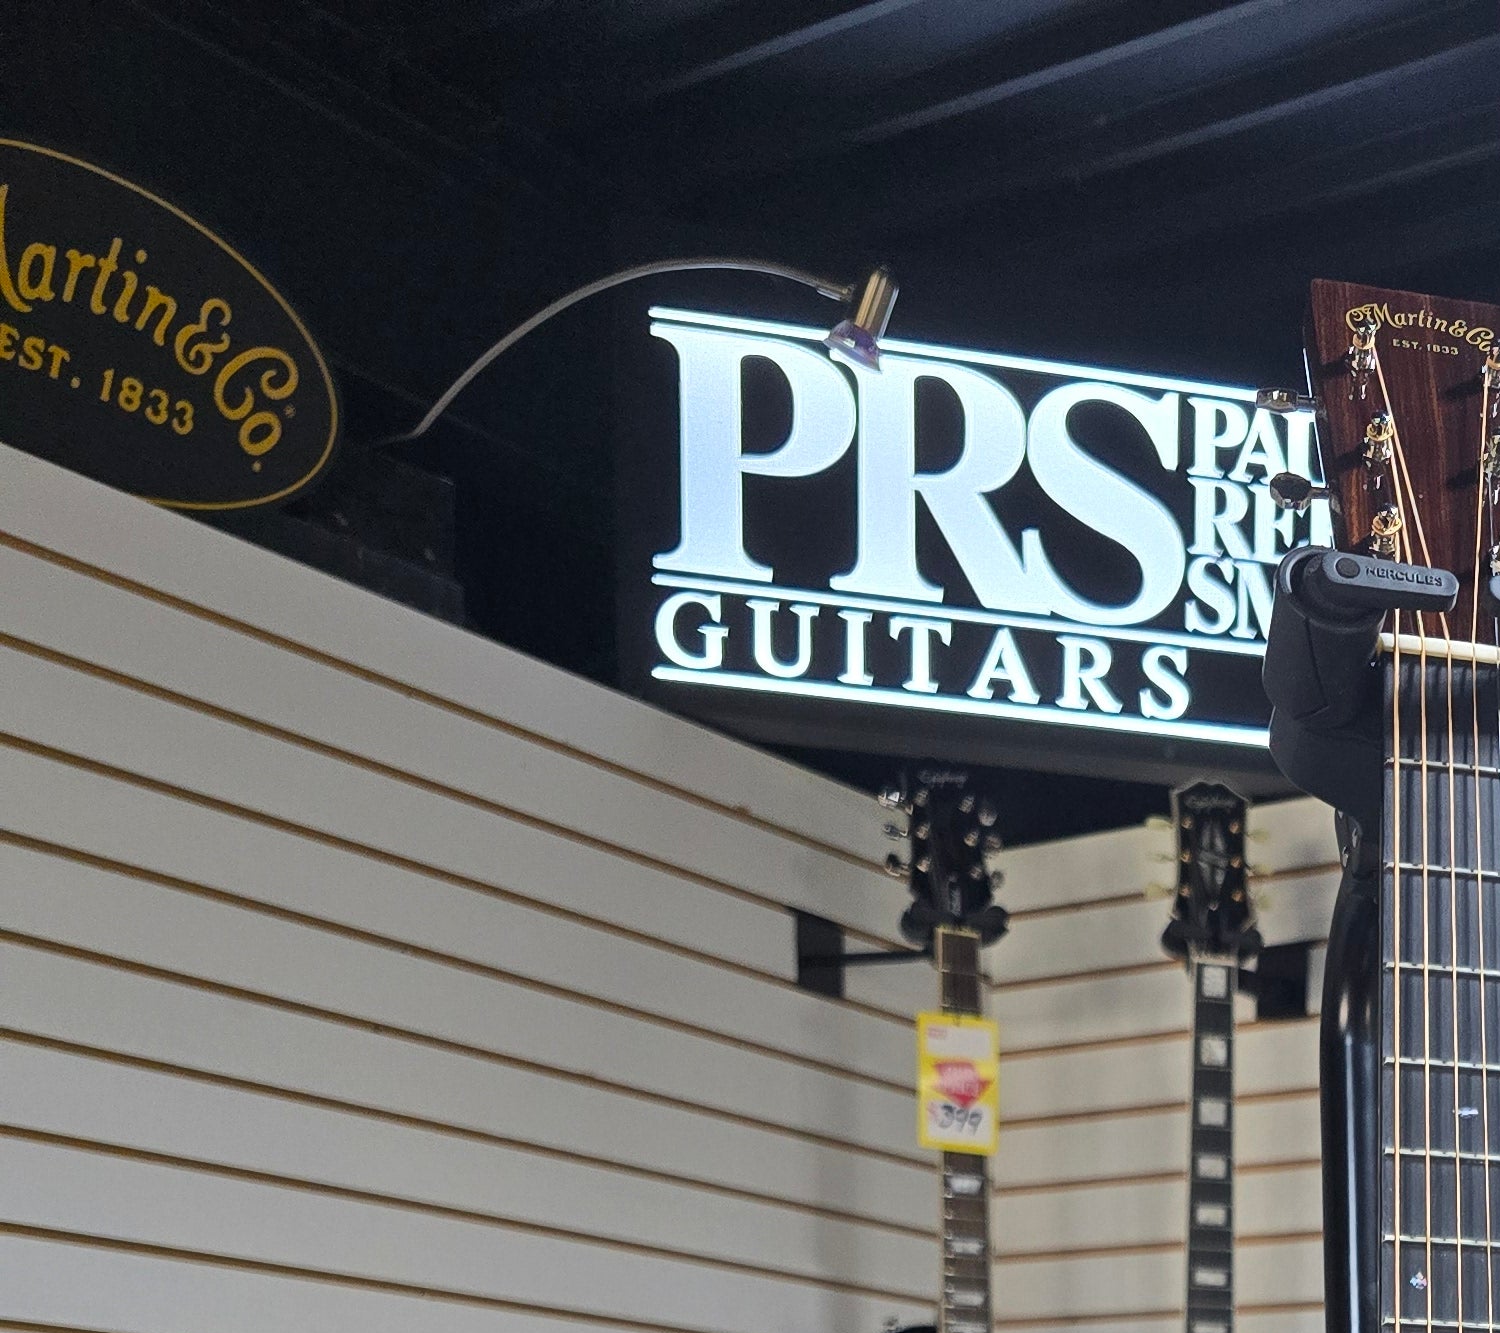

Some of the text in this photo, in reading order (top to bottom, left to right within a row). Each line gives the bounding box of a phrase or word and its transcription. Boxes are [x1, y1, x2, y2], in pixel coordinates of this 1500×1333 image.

[0, 323, 195, 436] EST. 1833
[1392, 338, 1422, 351] EST.
[650, 321, 1186, 627] PRS
[1365, 567, 1443, 587] HERCULES
[654, 594, 1190, 720] GUITARS
